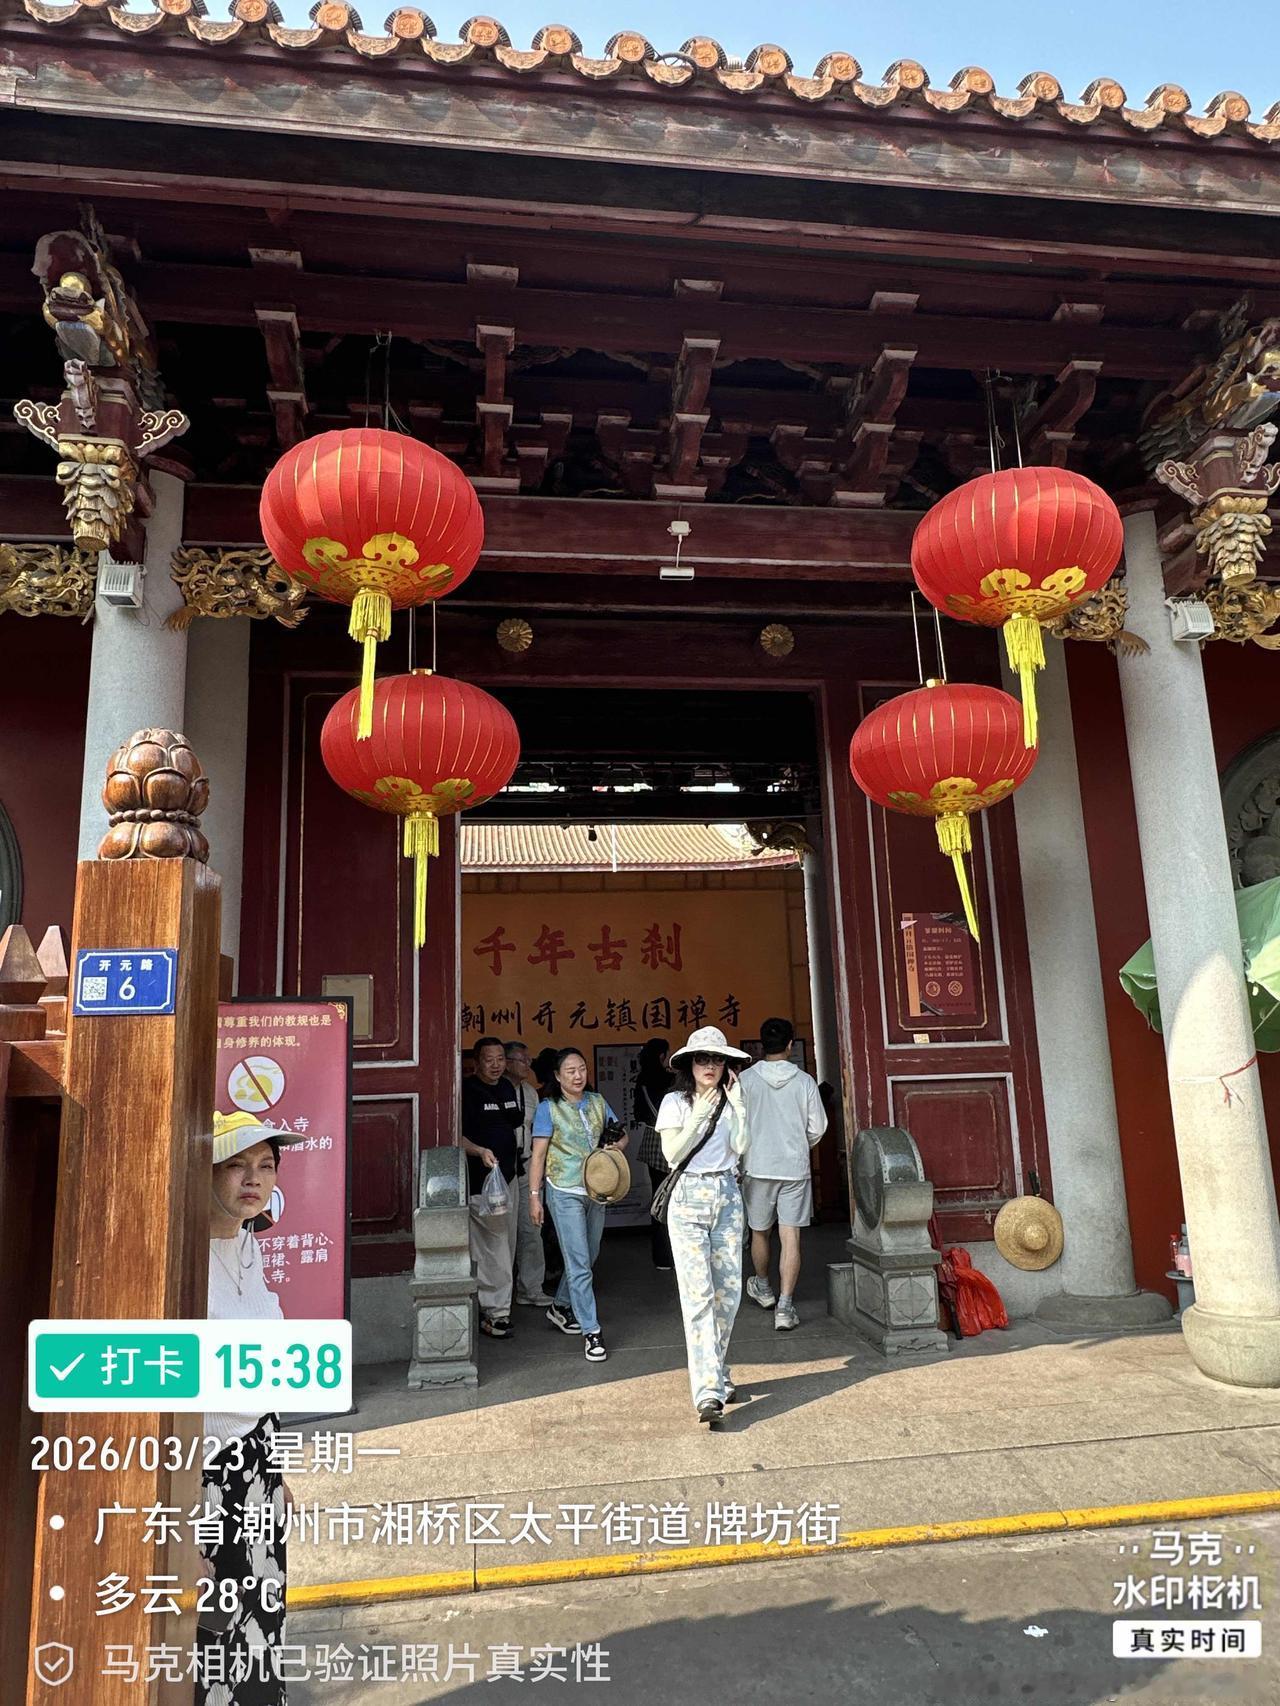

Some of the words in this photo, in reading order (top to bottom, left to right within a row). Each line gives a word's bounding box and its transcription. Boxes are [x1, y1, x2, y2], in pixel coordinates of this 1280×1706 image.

[473, 922, 683, 976] 千年古刹
[99, 959, 153, 971] 开元路
[119, 976, 136, 1000] 6
